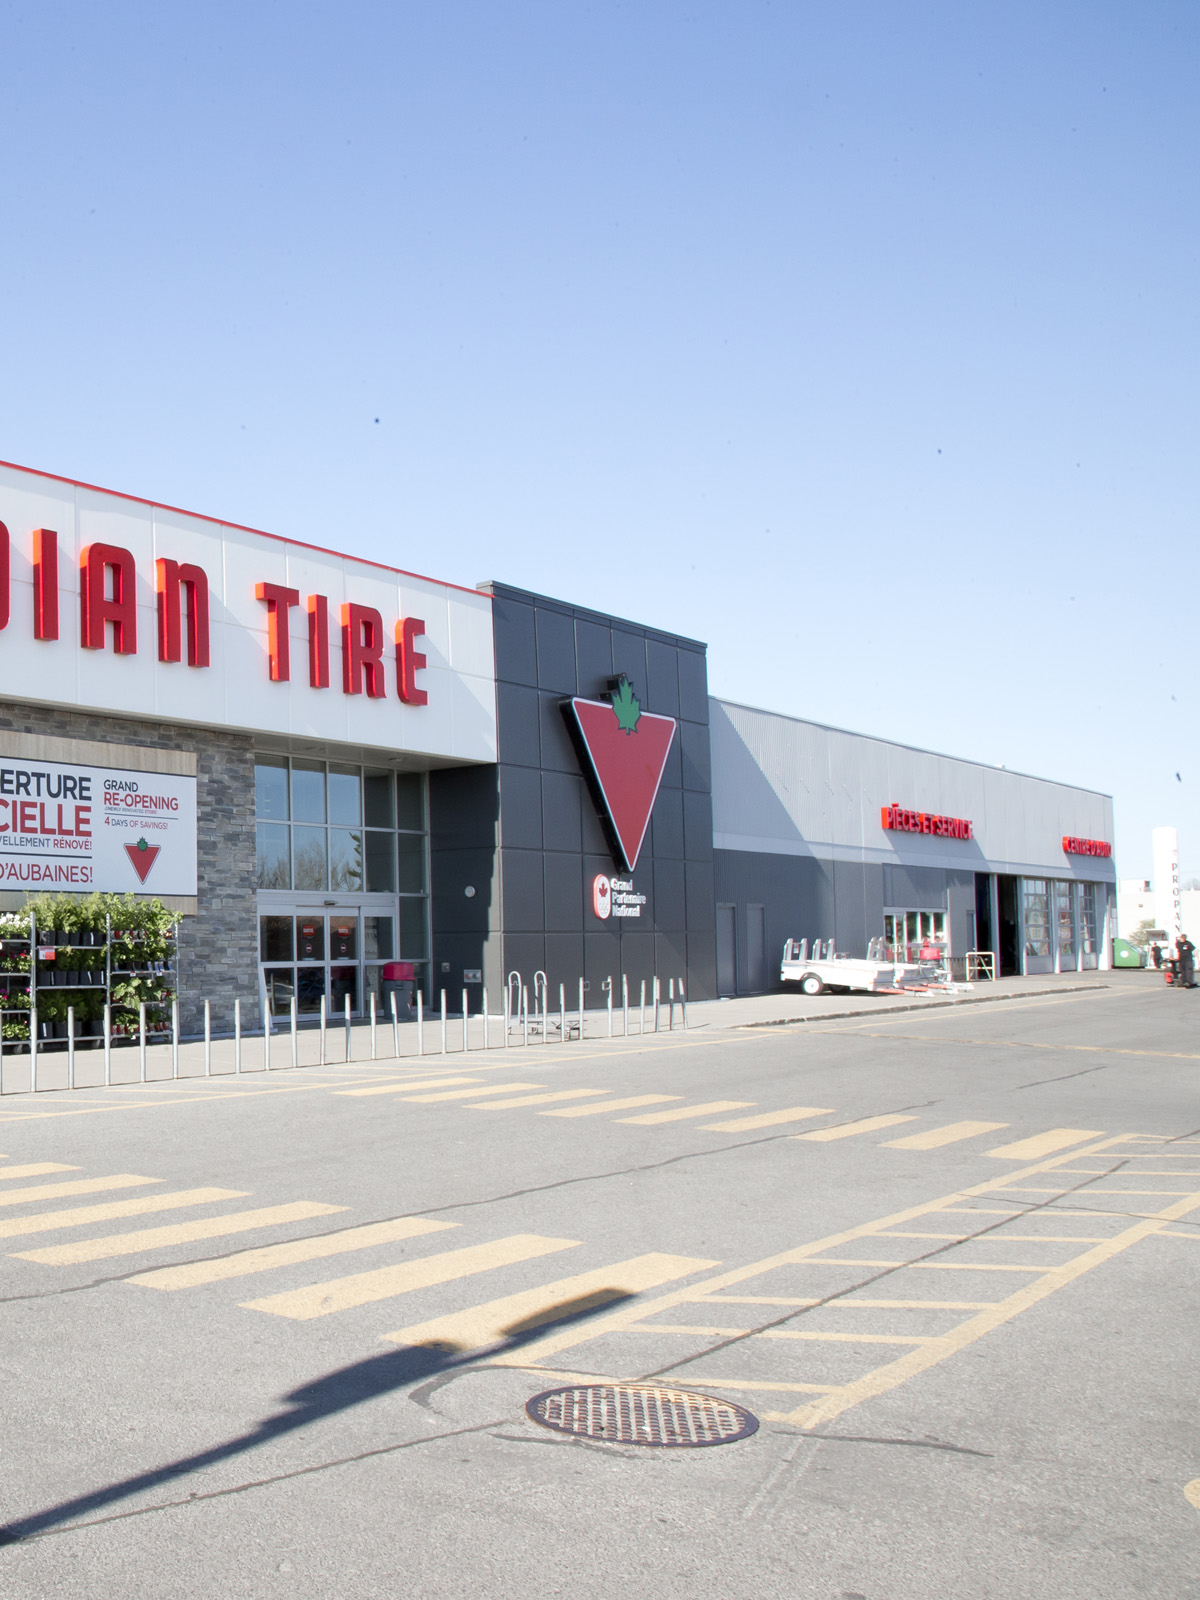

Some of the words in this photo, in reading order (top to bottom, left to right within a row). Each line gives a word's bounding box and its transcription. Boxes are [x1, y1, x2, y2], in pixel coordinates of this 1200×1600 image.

[255, 582, 429, 706] TIRE
[103, 779, 139, 793] GRAND
[103, 791, 179, 811] RE-OPENING
[104, 816, 110, 827] 4
[111, 818, 129, 828] DAYS
[129, 819, 139, 828] OF
[139, 820, 169, 831] SAVINGS!
[932, 815, 974, 840] SERVICE
[53, 836, 93, 850] RÉNOVÉ!
[610, 877, 634, 891] Grand
[611, 891, 647, 904] Partenaire
[611, 904, 641, 917] National
